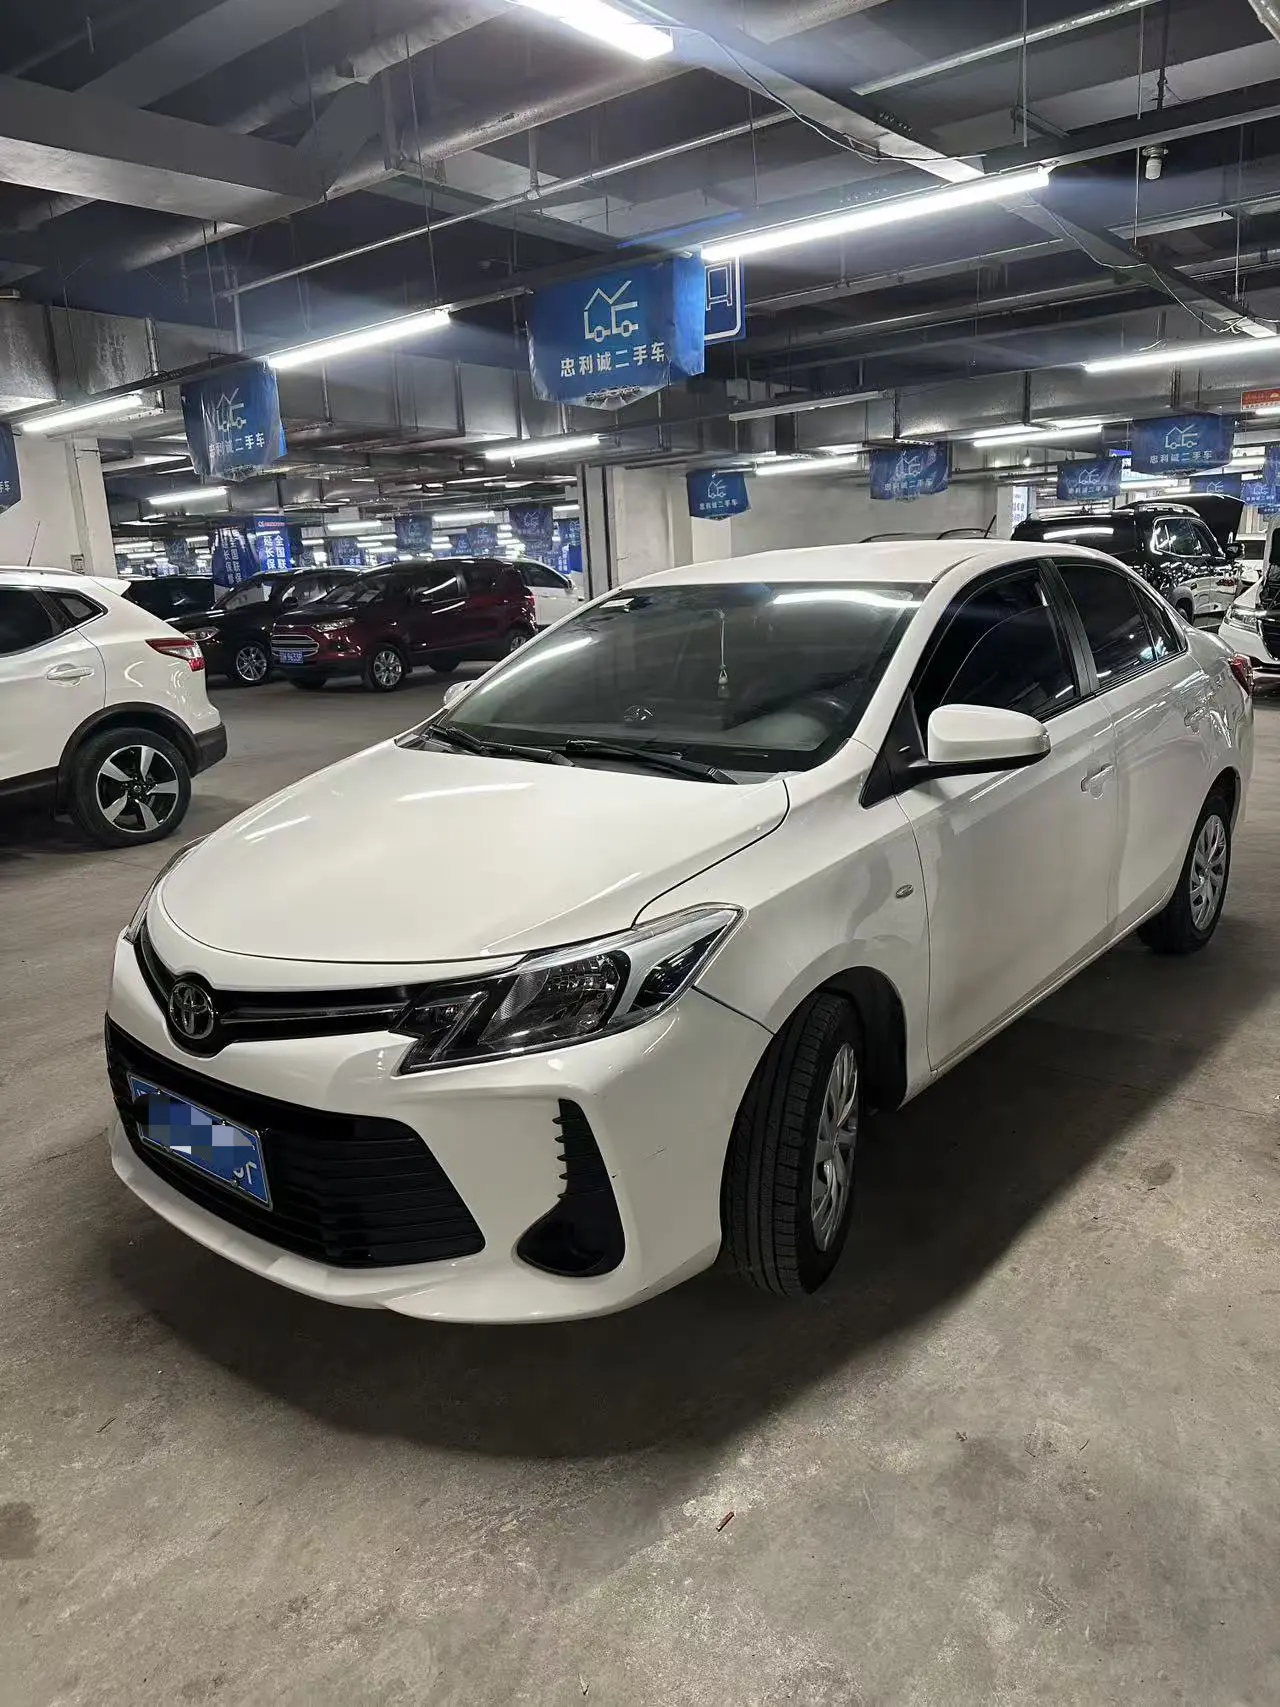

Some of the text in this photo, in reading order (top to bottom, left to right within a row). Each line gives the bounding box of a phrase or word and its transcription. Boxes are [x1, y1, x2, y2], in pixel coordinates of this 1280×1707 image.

[560, 341, 665, 377] 忠利诚二手车
